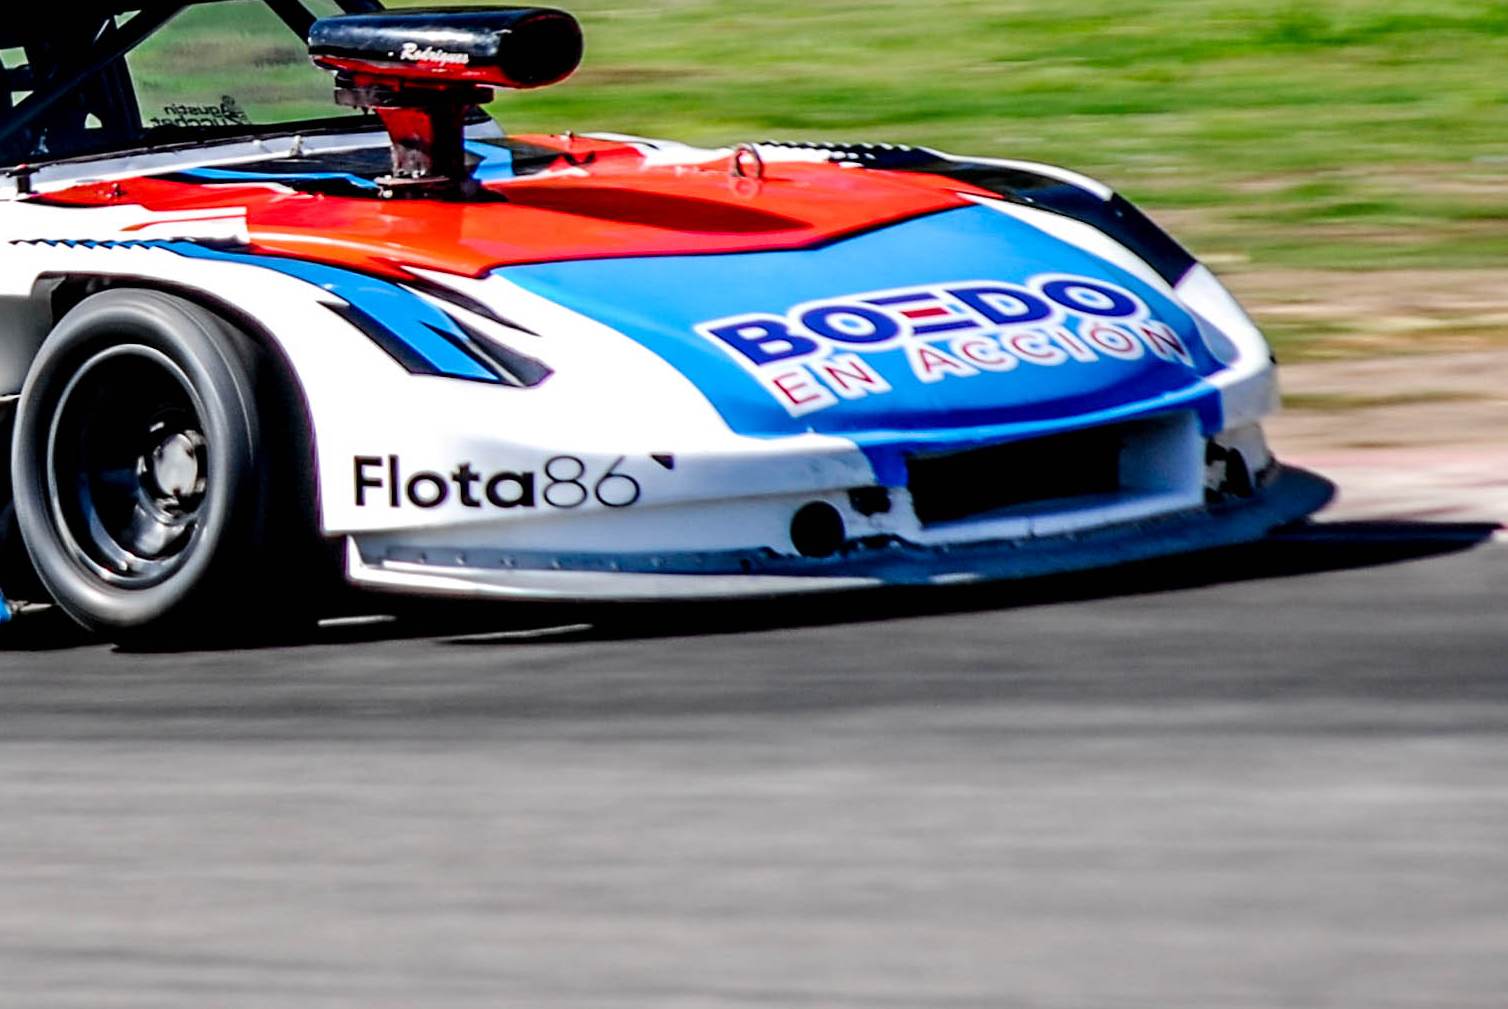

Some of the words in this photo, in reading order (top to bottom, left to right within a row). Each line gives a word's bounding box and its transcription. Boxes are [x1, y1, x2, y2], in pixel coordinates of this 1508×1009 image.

[708, 278, 1138, 367] BOEDO
[772, 360, 875, 405] EN
[353, 453, 640, 508] Flota86
